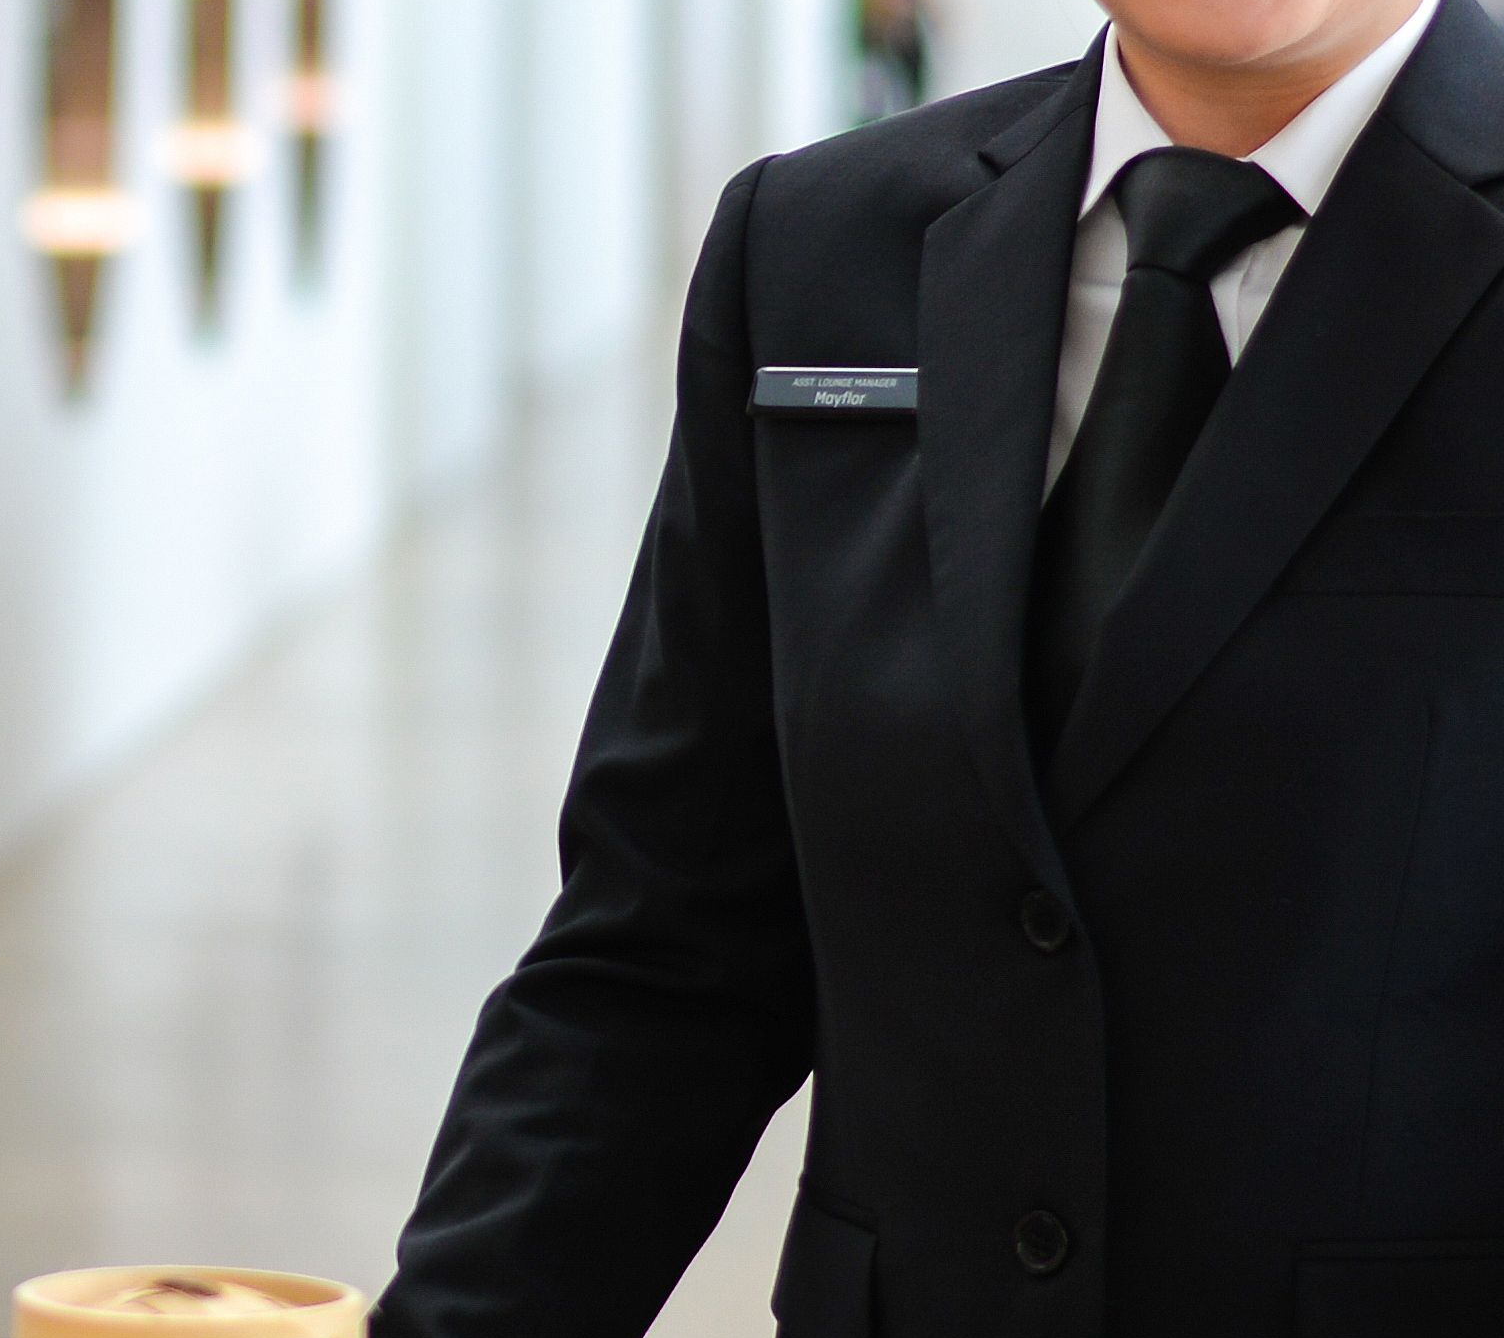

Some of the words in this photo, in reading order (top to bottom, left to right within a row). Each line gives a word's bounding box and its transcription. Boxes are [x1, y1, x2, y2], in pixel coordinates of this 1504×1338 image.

[818, 377, 853, 387] LOUNGE
[854, 378, 897, 388] MANAGER
[814, 391, 866, 407] Mayflor
